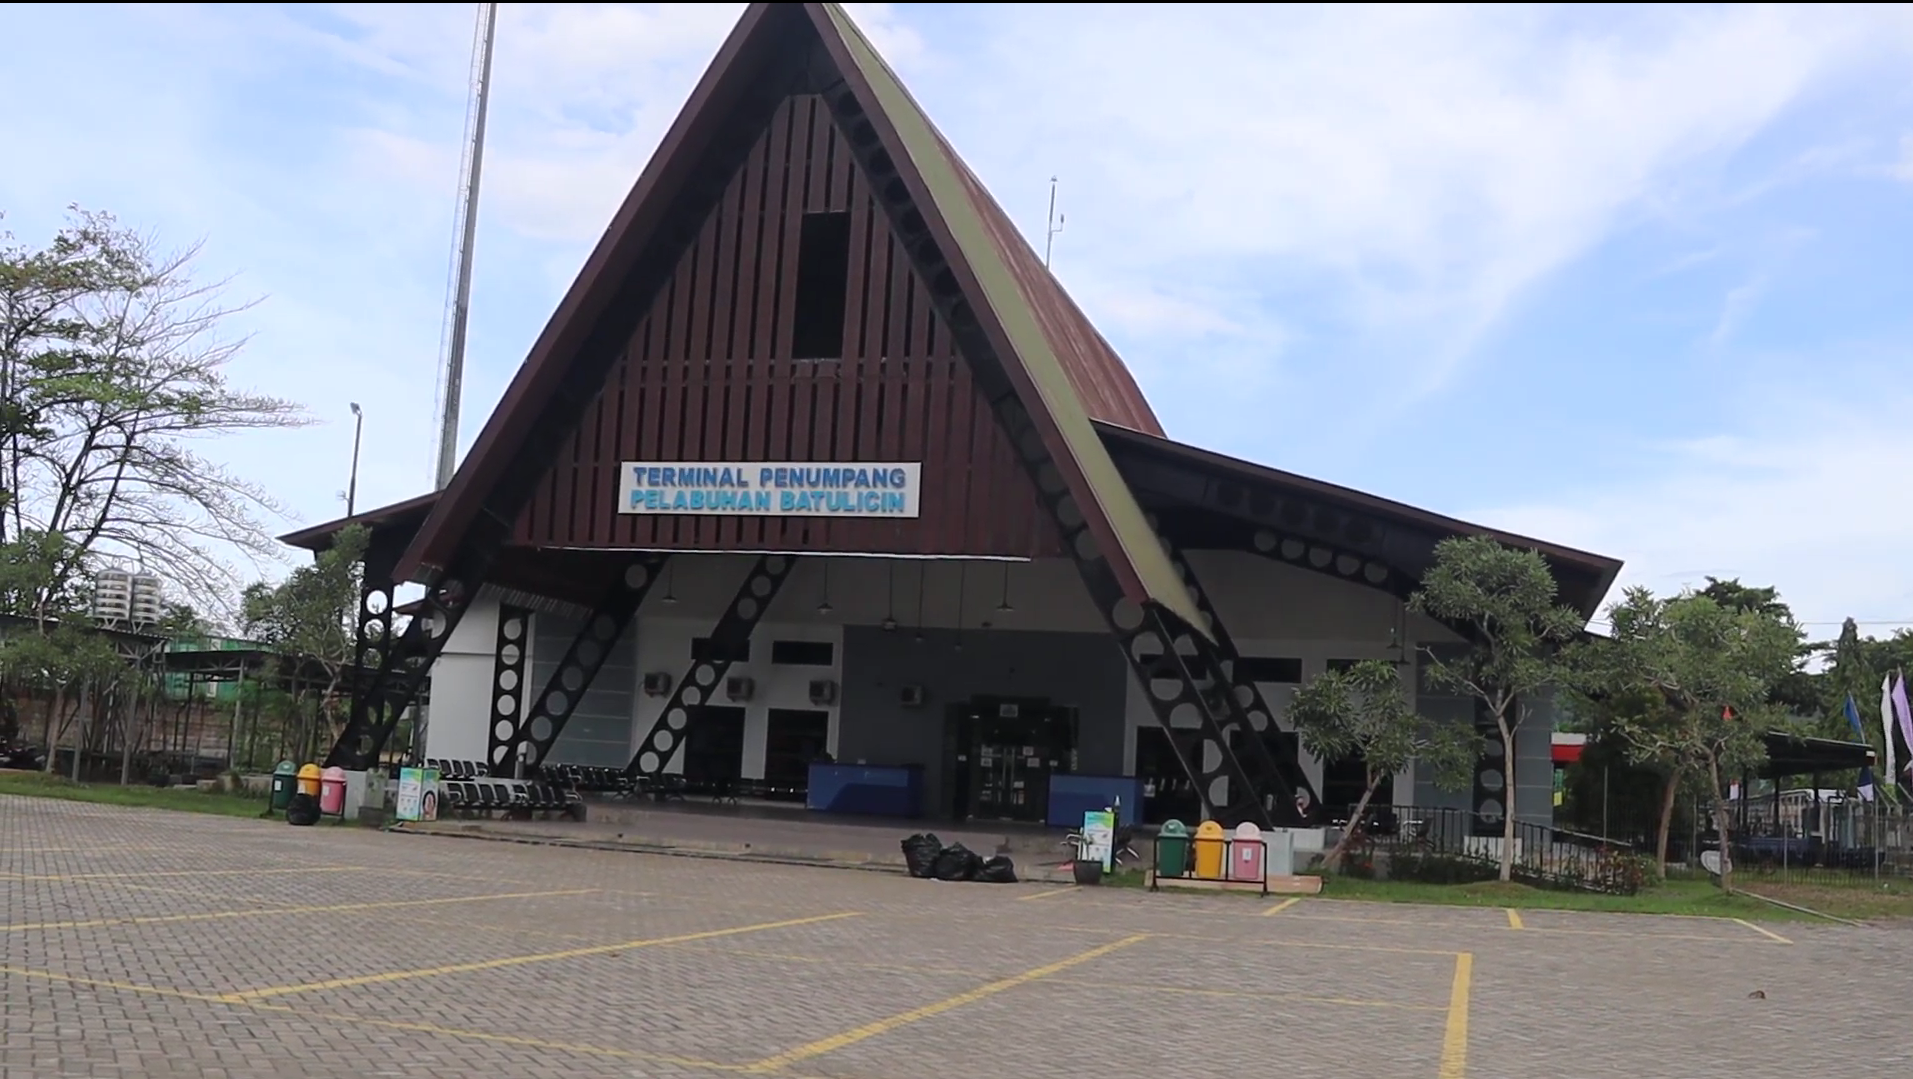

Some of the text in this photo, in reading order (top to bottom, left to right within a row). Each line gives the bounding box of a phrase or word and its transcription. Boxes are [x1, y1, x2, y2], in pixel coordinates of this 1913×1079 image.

[633, 466, 907, 489] TERMINAL PENUMPANG
[630, 489, 905, 513] PELABUHAN BATULICIN
